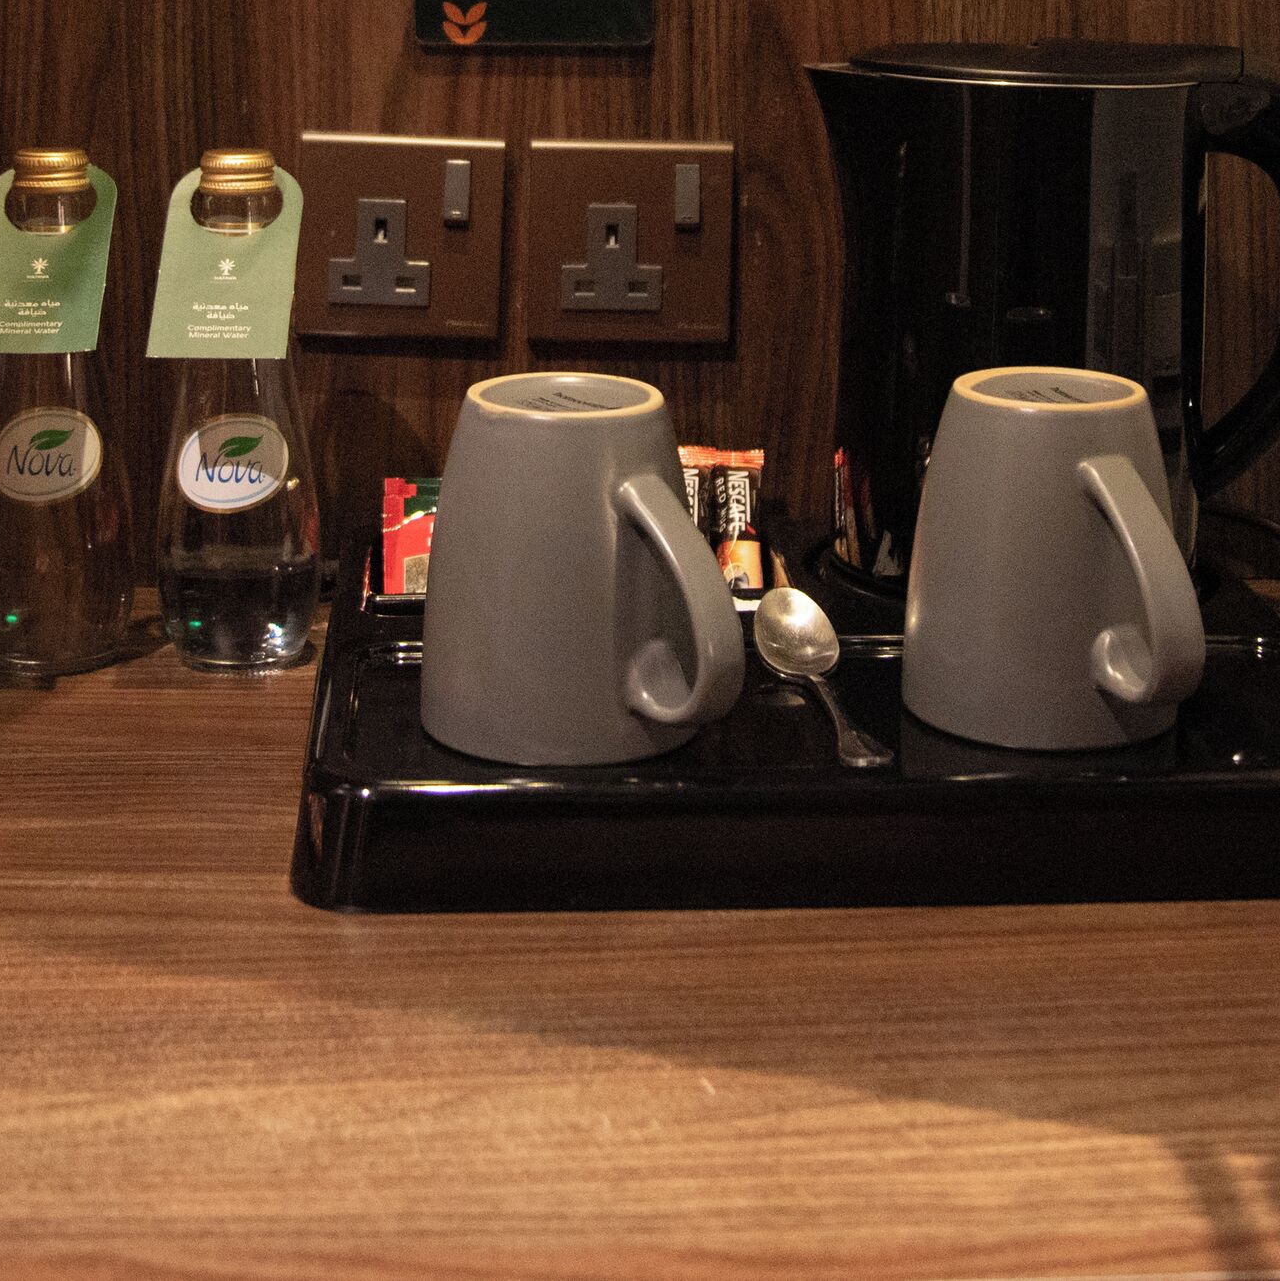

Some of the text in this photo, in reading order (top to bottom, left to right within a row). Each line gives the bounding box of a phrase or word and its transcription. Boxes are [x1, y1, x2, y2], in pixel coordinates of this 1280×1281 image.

[4, 299, 61, 309] مياه معدنية
[192, 301, 249, 312] مياه معدنية
[187, 324, 252, 333] Complimentary
[6, 444, 74, 477] Nova
[195, 451, 263, 484] Nova
[715, 476, 727, 504] RED
